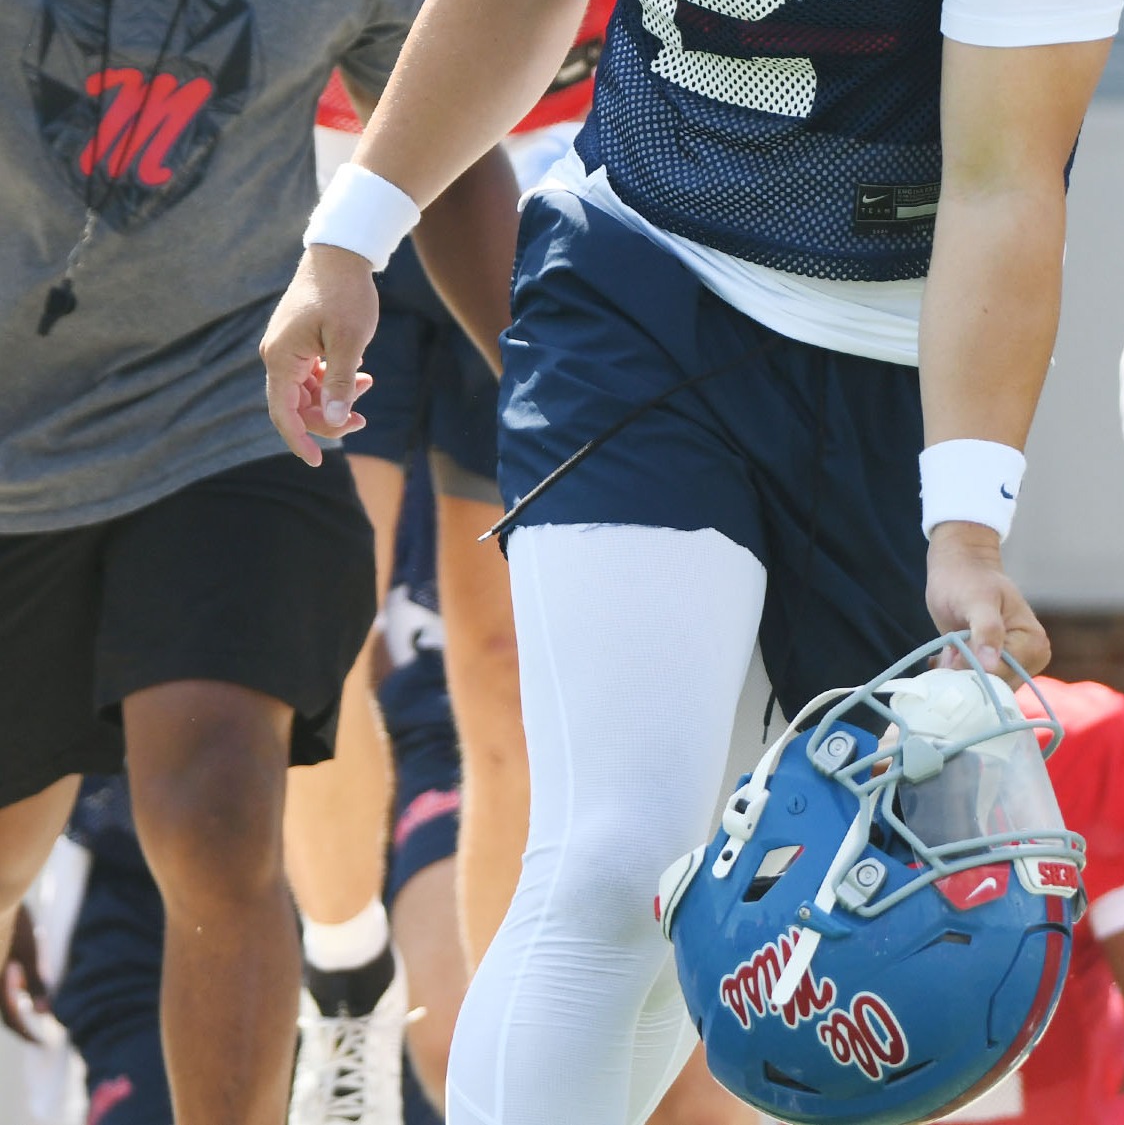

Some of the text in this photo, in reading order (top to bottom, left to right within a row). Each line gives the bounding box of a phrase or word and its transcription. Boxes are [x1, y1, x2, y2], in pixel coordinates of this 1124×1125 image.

[79, 67, 212, 187] M
[720, 925, 837, 1030] Miss
[817, 991, 909, 1081] Ole
